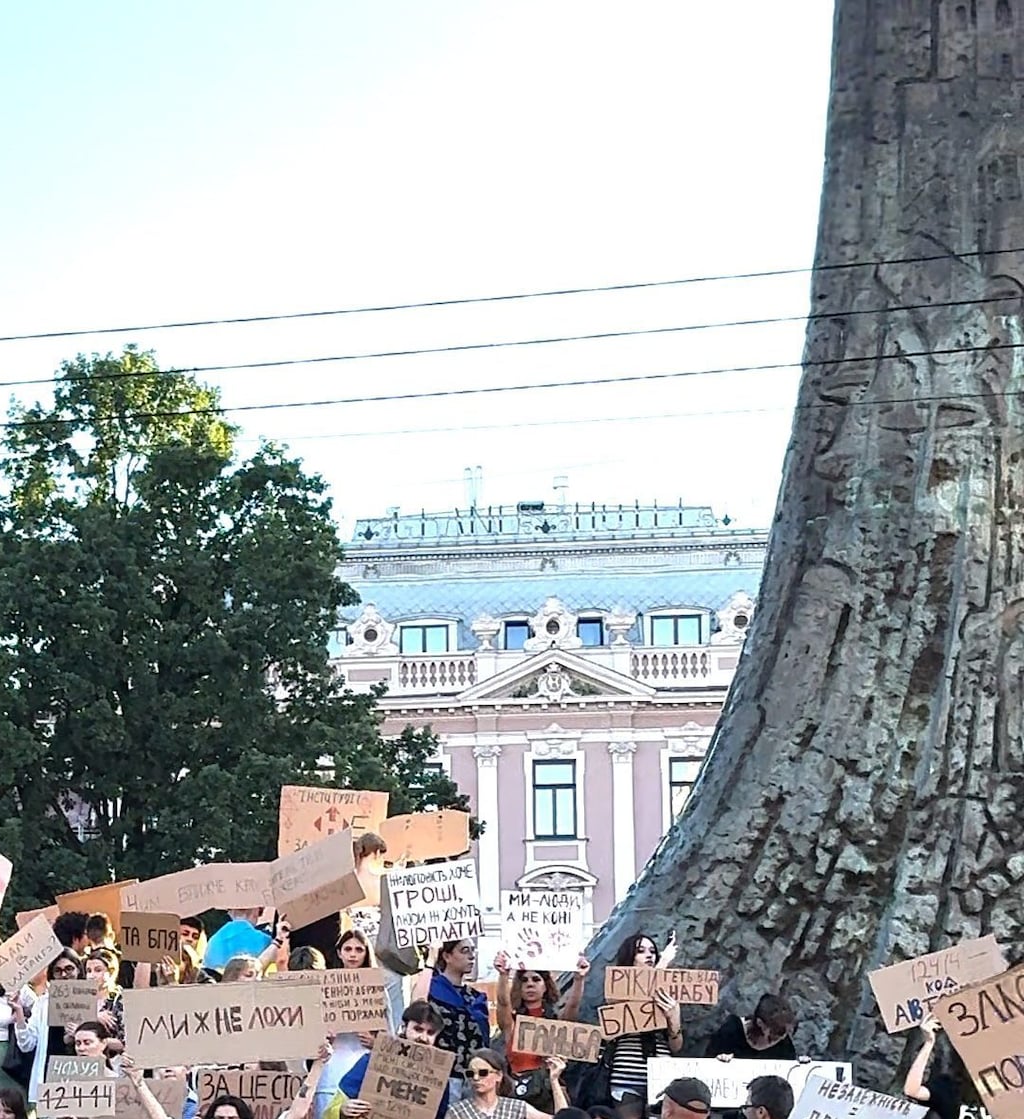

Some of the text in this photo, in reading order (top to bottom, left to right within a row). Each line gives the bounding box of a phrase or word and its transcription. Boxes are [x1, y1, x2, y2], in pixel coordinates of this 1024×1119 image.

[393, 884, 463, 909] ГРОШІ,
[398, 916, 485, 946] ВІДПЛАТИ!
[506, 911, 571, 924] А НЕ КОНІ
[122, 926, 140, 947] ТА
[611, 969, 658, 997] РУКИ
[663, 970, 693, 984] ГЕТЬ
[670, 984, 713, 1003] НАБУ
[138, 1005, 304, 1044] МИ Ж НЕ ЛОХИ
[600, 1002, 658, 1036] БЛЯ
[517, 1020, 603, 1059] ГАНЬБА
[40, 1085, 113, 1110] 12414
[202, 1073, 231, 1101] ЗА
[239, 1075, 268, 1102] ЦЕ
[377, 1075, 430, 1105] МЕНЕ
[818, 1080, 911, 1115] НЕЗАЛЕЖНІСТЬ
